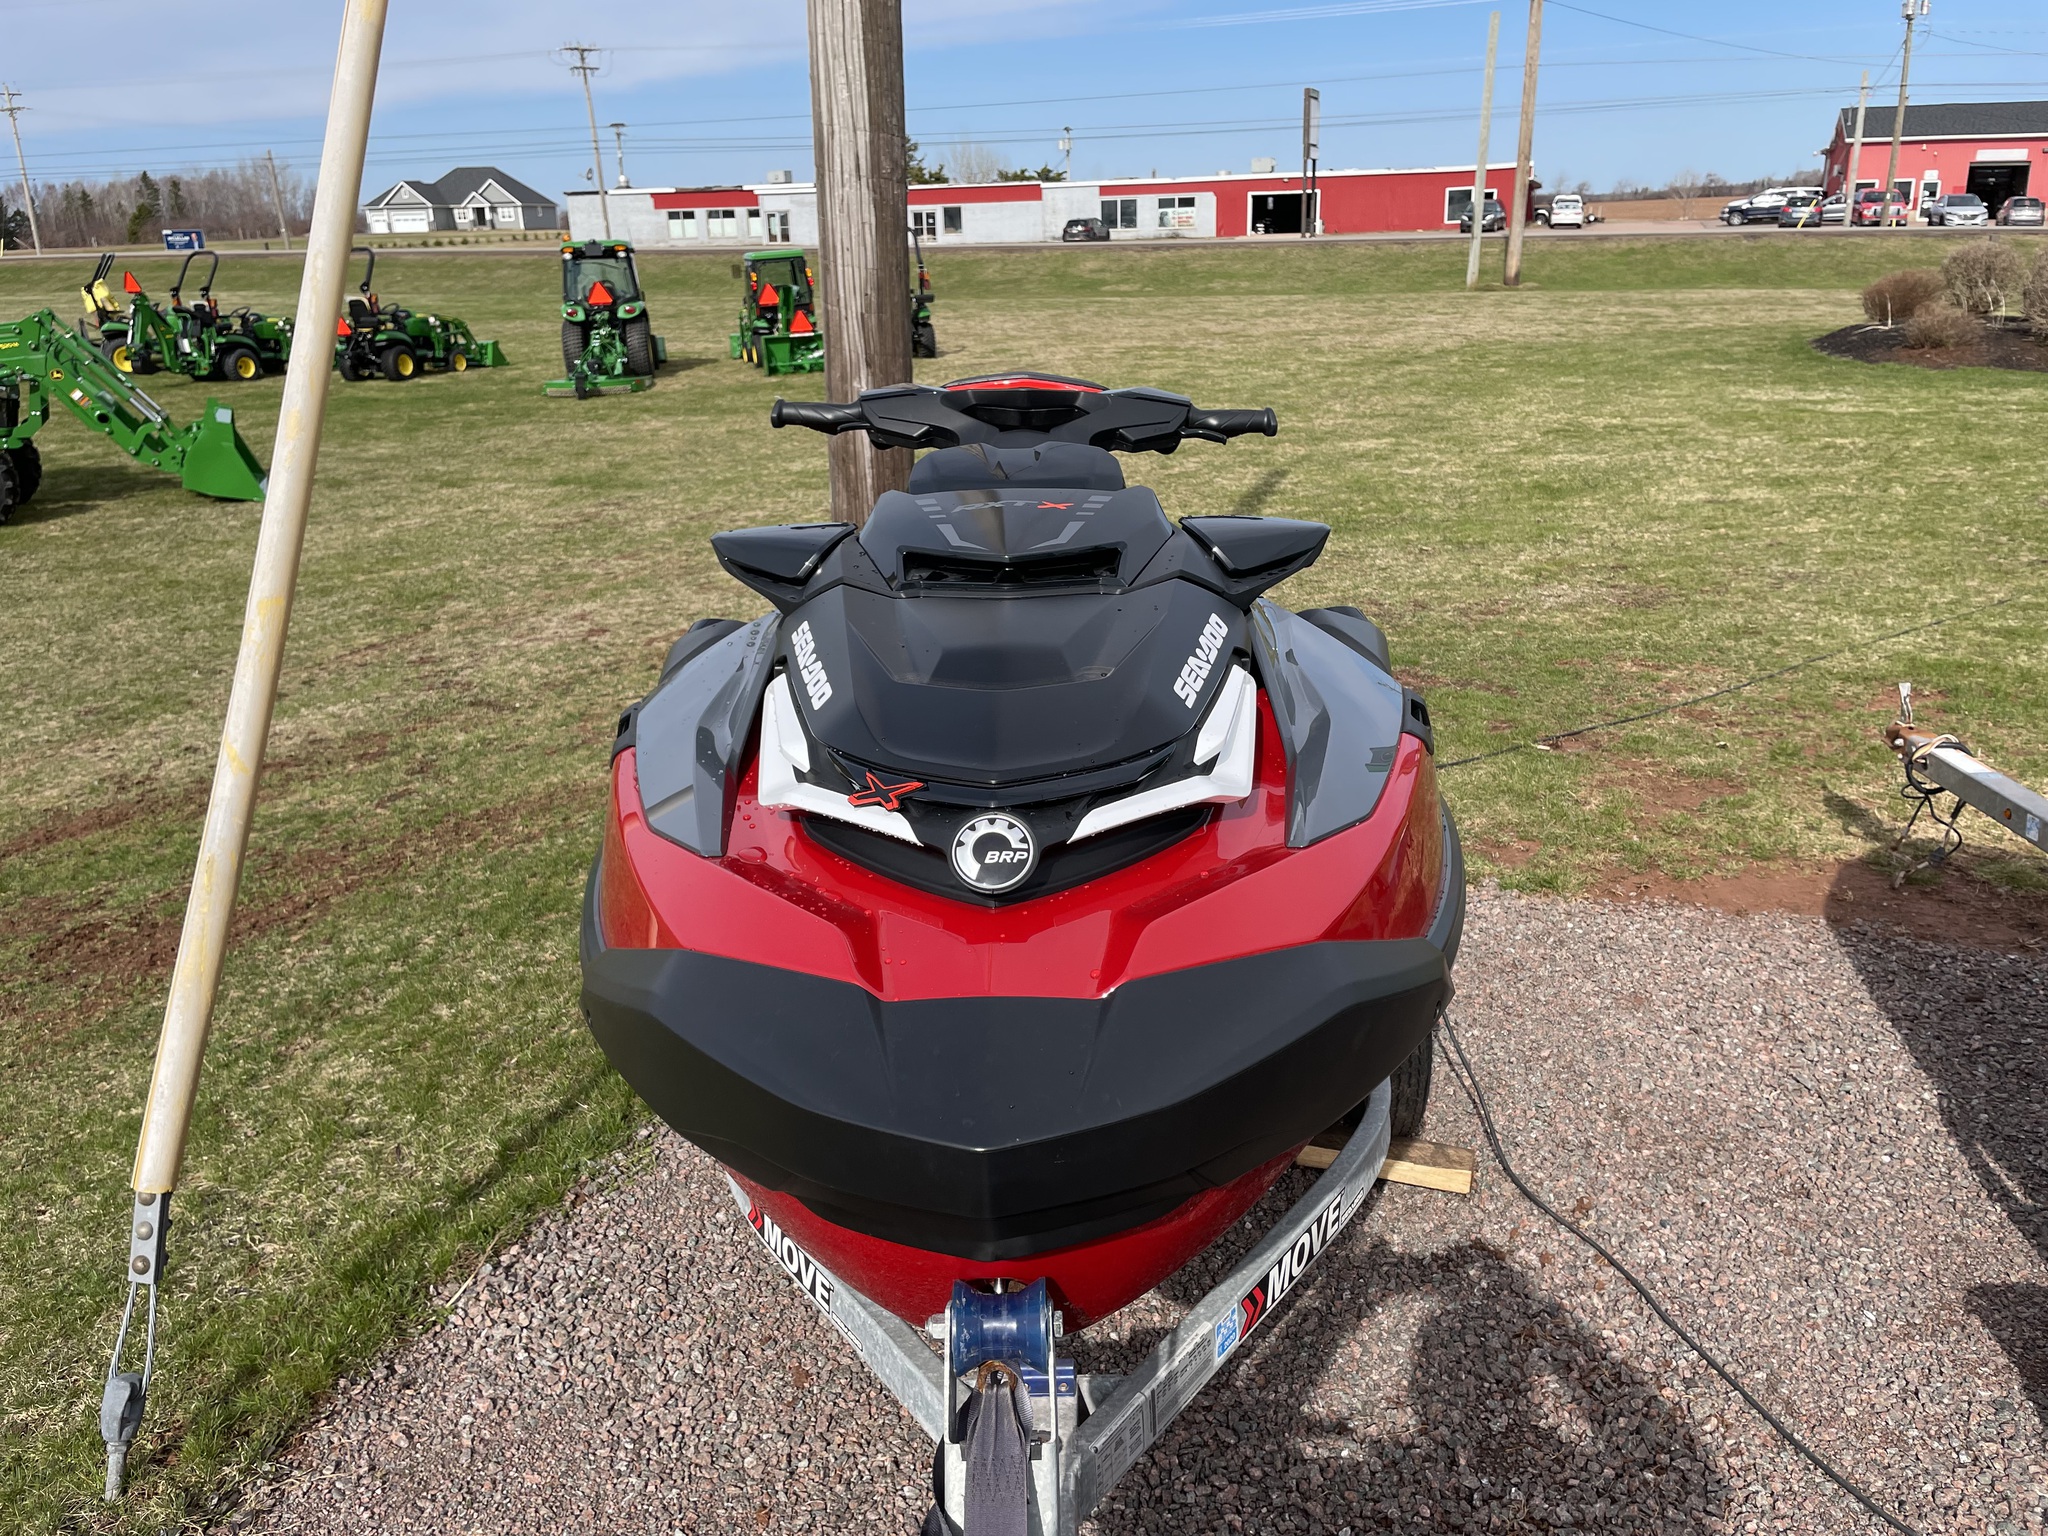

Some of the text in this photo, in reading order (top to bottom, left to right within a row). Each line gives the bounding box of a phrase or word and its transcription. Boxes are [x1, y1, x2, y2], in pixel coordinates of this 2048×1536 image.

[984, 850, 1029, 864] BRP
[763, 1213, 831, 1315] MOVE
[1265, 1194, 1342, 1310] MOVE
